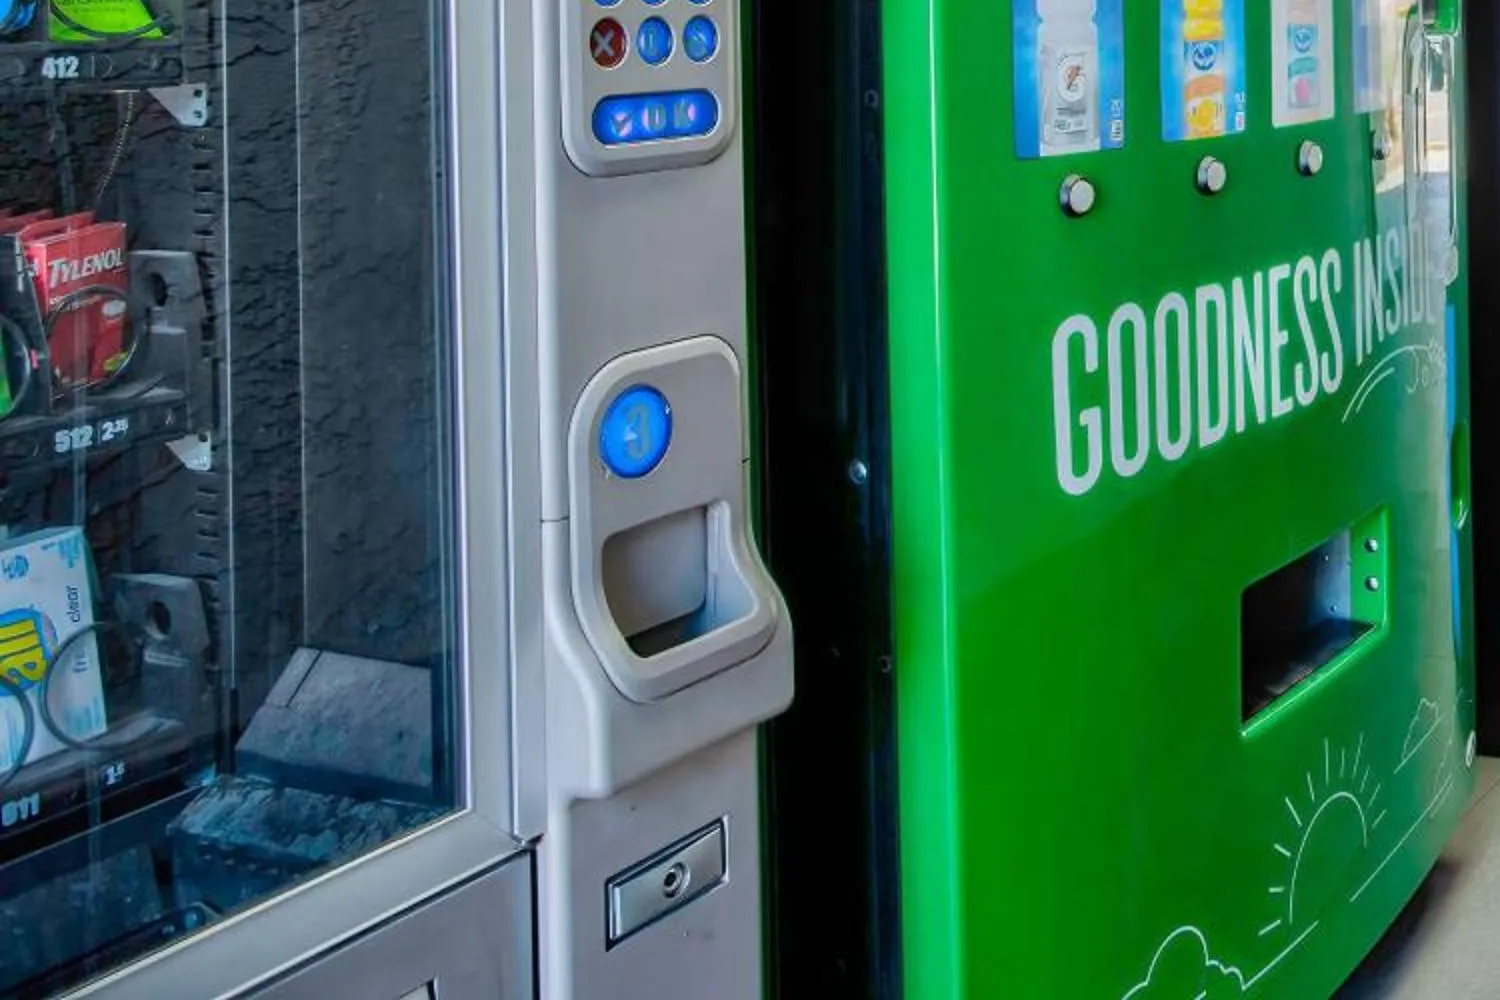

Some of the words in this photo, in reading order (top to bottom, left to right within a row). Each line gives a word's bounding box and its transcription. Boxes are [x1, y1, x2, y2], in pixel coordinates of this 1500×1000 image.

[41, 56, 80, 79] 412
[48, 248, 124, 289] TYLENOL
[1051, 246, 1344, 497] GOODNESS
